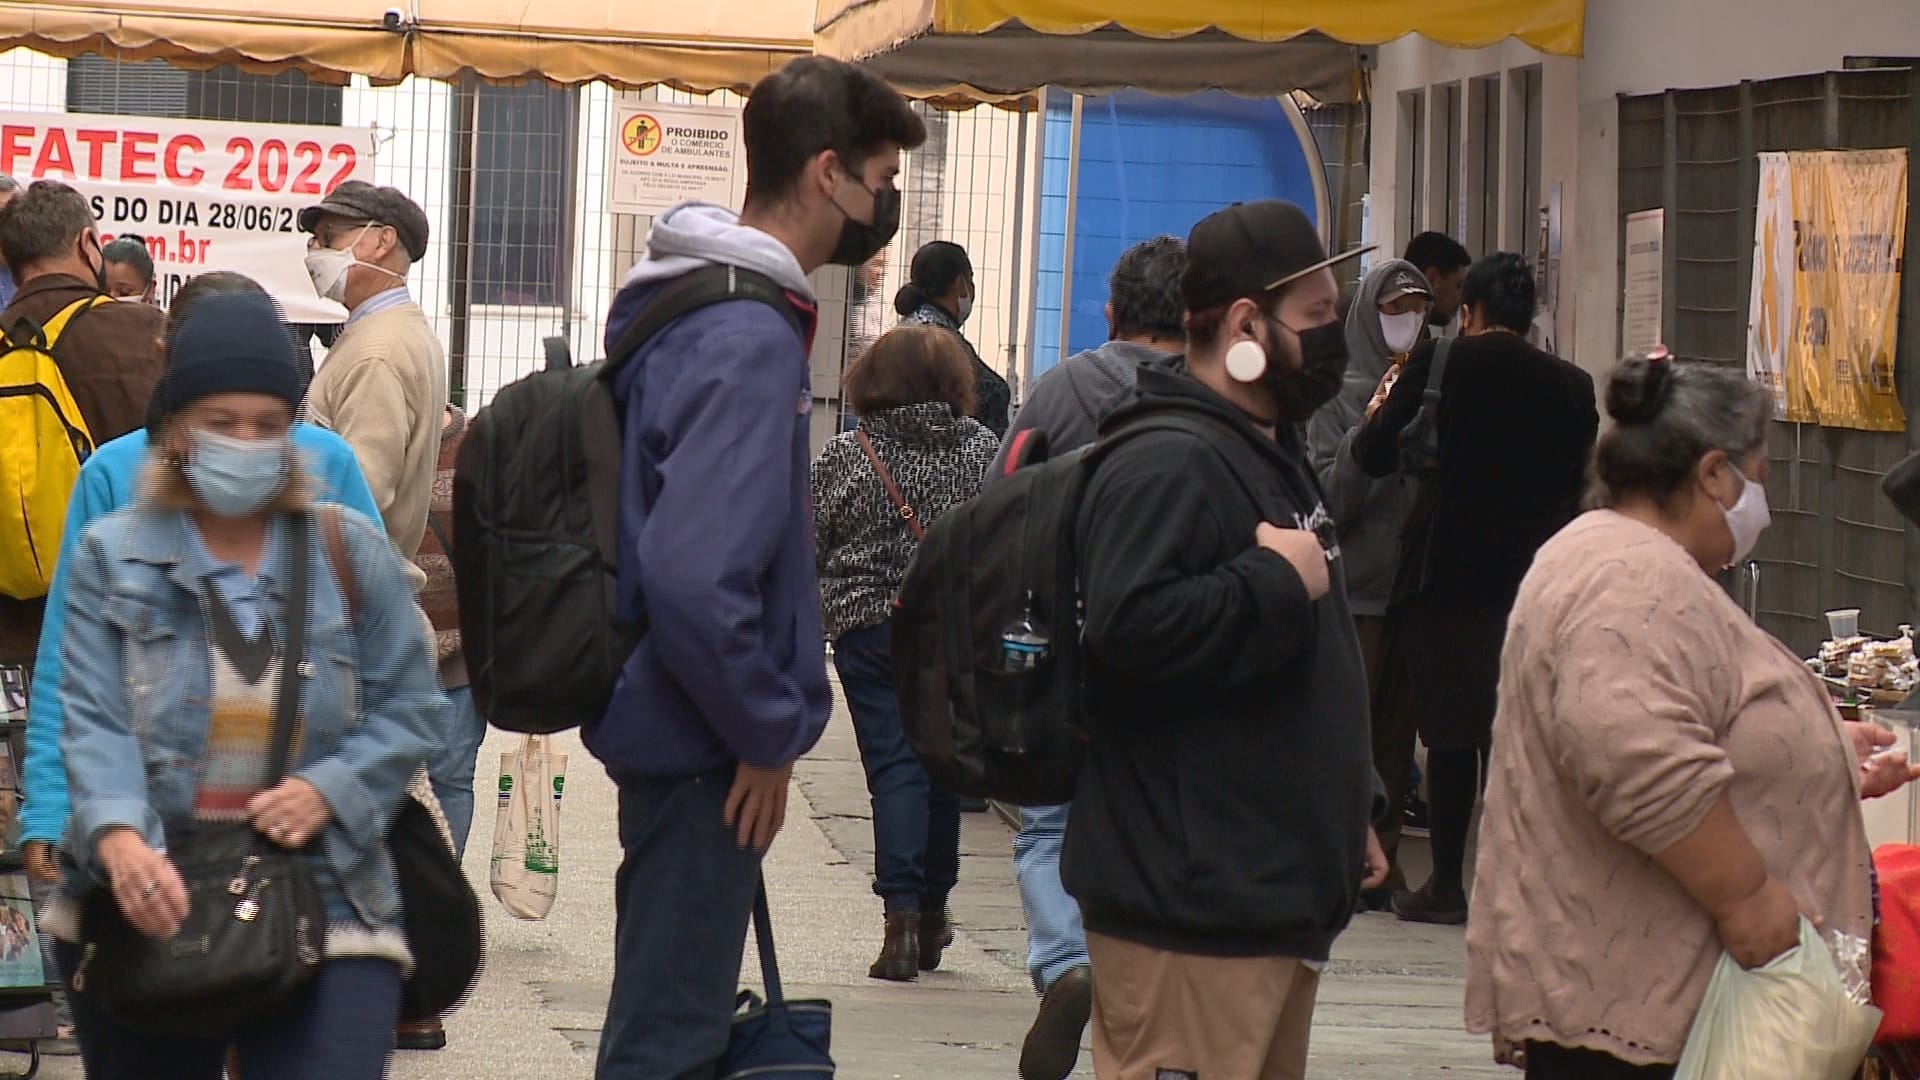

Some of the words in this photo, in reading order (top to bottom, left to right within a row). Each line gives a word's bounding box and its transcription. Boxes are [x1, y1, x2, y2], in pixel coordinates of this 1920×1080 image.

[666, 127, 729, 141] PROIBIDO
[671, 138, 678, 146] O
[661, 146, 673, 154] DE
[674, 147, 731, 158] AMBULANTES
[1, 124, 206, 186] FATEC
[222, 137, 357, 195] 2022
[113, 196, 148, 223] DO
[158, 200, 199, 226] DIA
